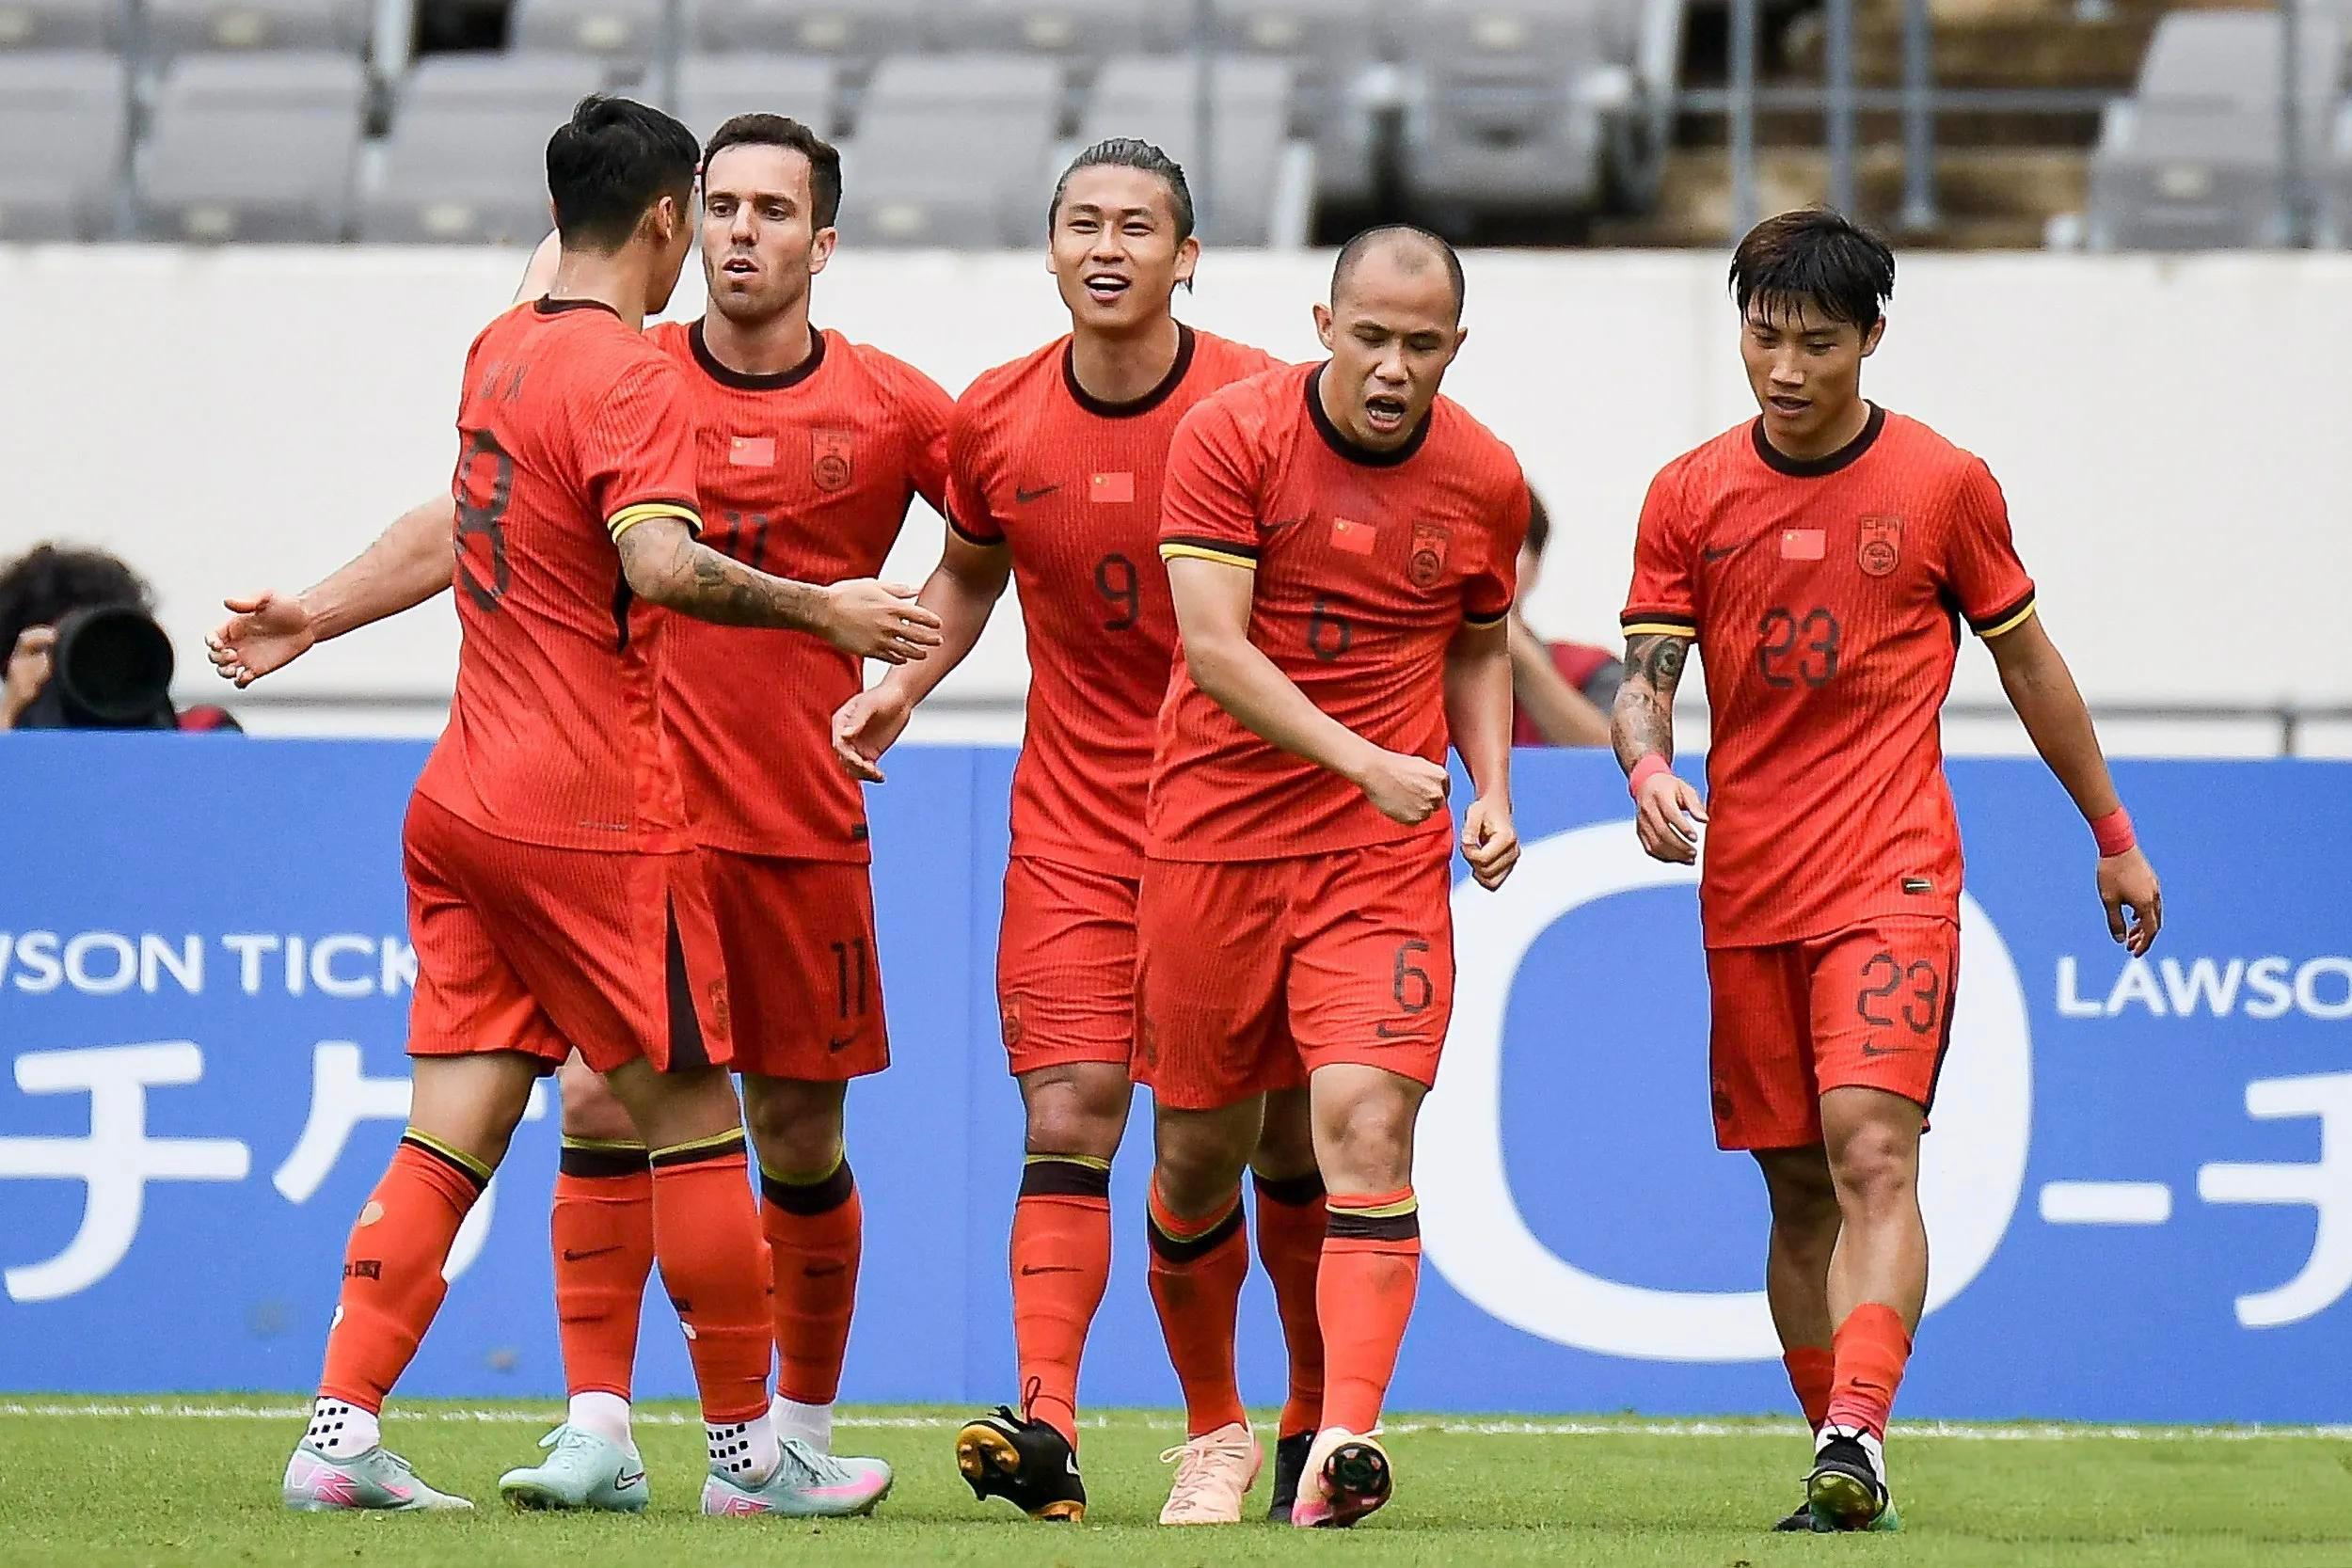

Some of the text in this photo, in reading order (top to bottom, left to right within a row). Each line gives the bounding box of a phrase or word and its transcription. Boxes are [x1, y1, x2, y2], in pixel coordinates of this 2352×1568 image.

[457, 428, 513, 612] 8
[724, 510, 768, 569] 11
[1094, 551, 1139, 630] 9
[1308, 592, 1351, 662] 6
[1757, 606, 1838, 688] 23
[0, 933, 203, 993] SON
[832, 938, 866, 1018] 11
[1394, 940, 1432, 1014] 6
[1858, 952, 1939, 1034] 23
[2057, 955, 2352, 1019] LAWSO
